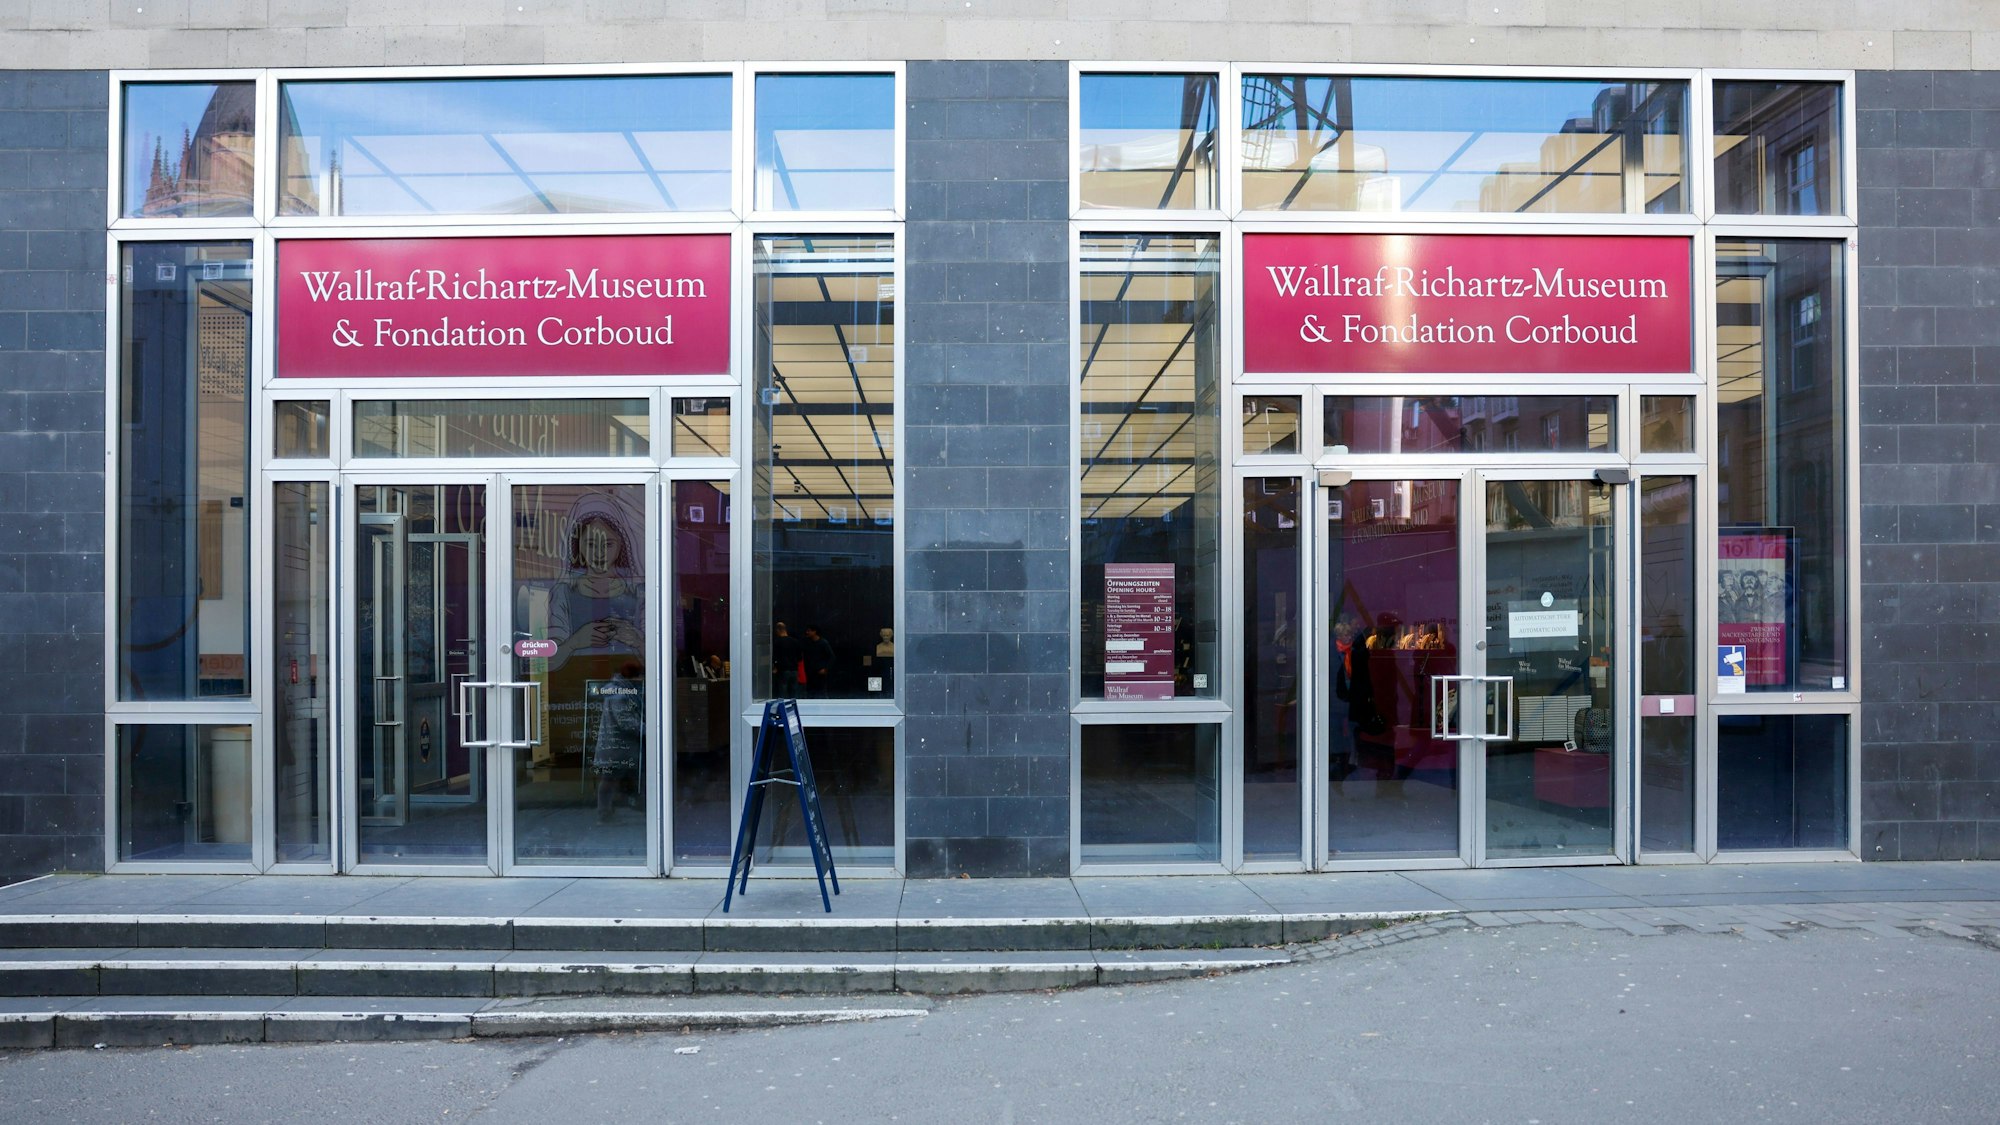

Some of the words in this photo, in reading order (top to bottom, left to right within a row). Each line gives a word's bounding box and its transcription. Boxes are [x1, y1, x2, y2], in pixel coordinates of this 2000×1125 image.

[300, 268, 707, 302] Wallraf-Richartz-Museum
[1266, 265, 1668, 298] Wallraf-Richartz-Museum
[332, 319, 365, 347] &
[373, 316, 528, 347] Fondation
[537, 316, 675, 346] Corboud
[1299, 314, 1333, 343] &
[1341, 314, 1496, 344] Fondation
[1505, 314, 1639, 344] Corboud
[1107, 579, 1160, 587] ÖFFNUNGSZEITEN
[521, 641, 549, 649] drücken
[521, 649, 538, 657] push
